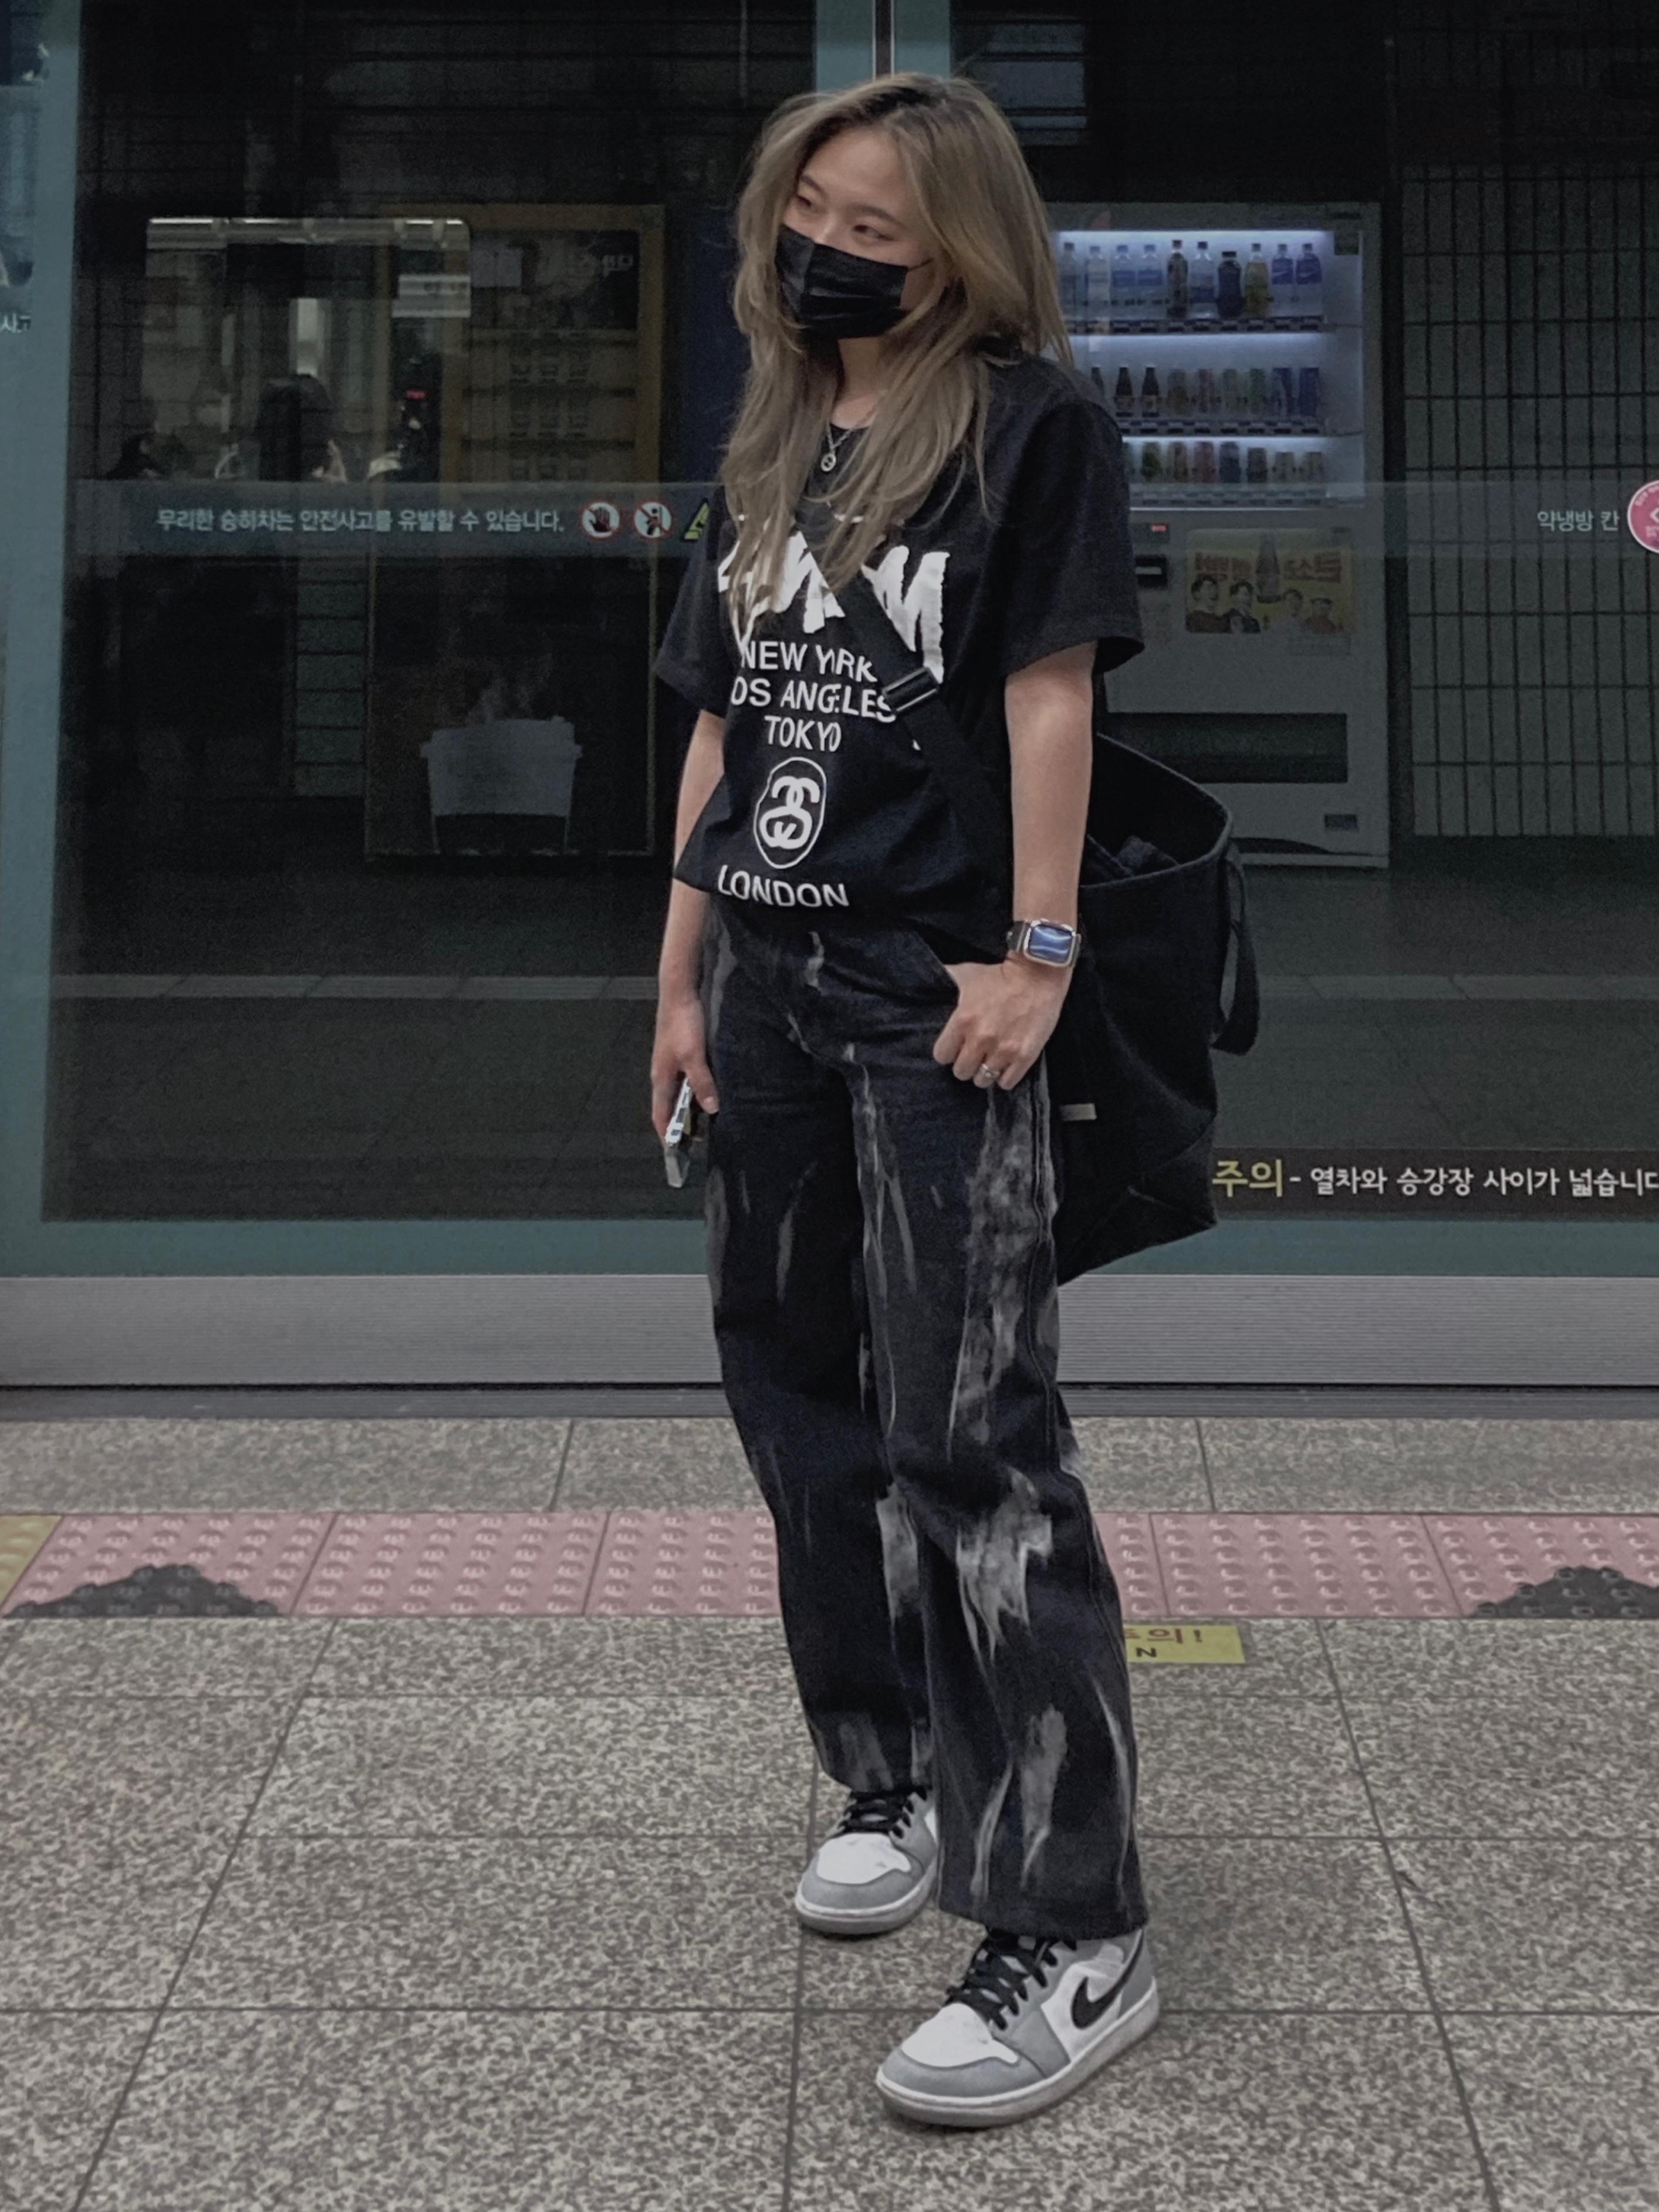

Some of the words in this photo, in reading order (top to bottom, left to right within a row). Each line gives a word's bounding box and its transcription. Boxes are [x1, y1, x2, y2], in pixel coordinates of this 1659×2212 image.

[156, 509, 214, 532] 무리한
[221, 508, 294, 532] 승하차는
[300, 508, 393, 532] 안전사고를
[397, 509, 454, 532] 유발할
[458, 509, 480, 532] 수
[486, 509, 565, 532] 있습니다.
[1536, 509, 1594, 532] 약냉방
[1600, 509, 1620, 532] 칸
[741, 640, 808, 672] NEW
[815, 644, 878, 683] YRK
[764, 714, 842, 752] TOKYO
[717, 864, 850, 908] LONDON
[1211, 1158, 1283, 1198] 주의
[1310, 1166, 1388, 1196] 열차와
[1396, 1166, 1475, 1197] 승강장
[1482, 1167, 1561, 1197] 사이가
